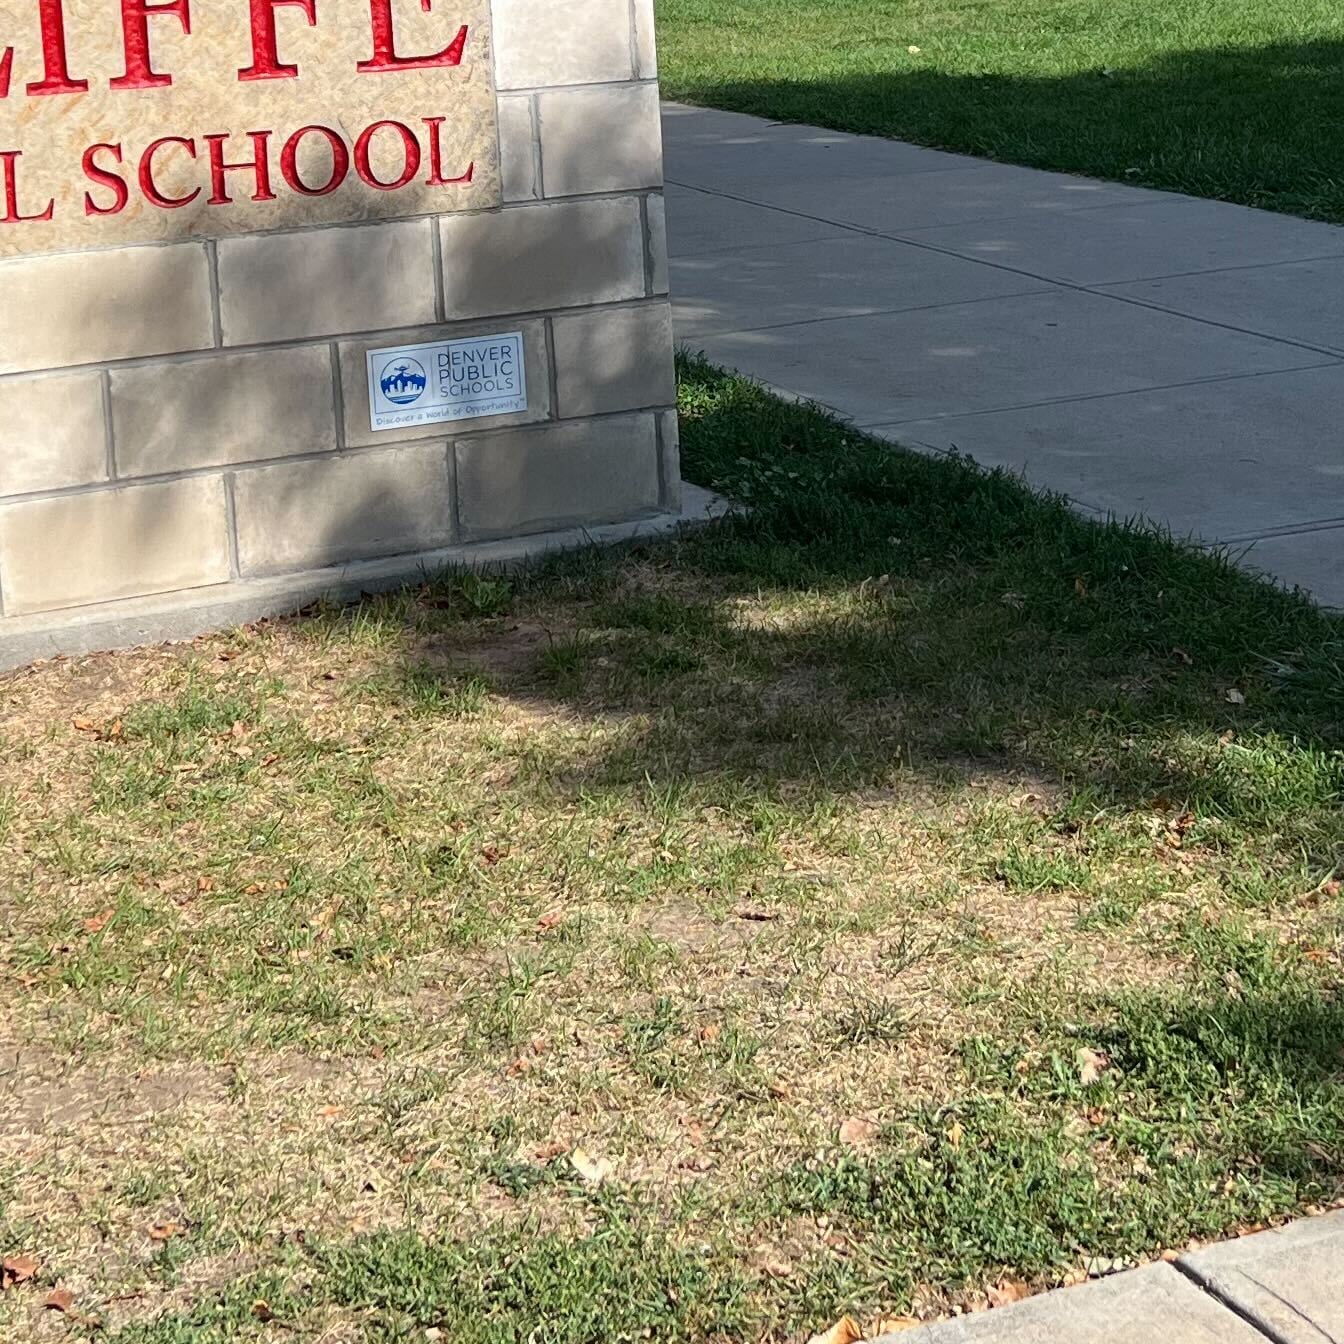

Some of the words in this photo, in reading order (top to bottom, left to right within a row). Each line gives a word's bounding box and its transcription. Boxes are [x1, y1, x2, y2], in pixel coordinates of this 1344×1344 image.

[80, 116, 474, 217] SCHOOL
[438, 345, 512, 368] DENVER
[439, 361, 513, 384] PUBLIC
[440, 377, 514, 398] SCHOOLS
[376, 414, 414, 425] Discover
[426, 408, 449, 419] World
